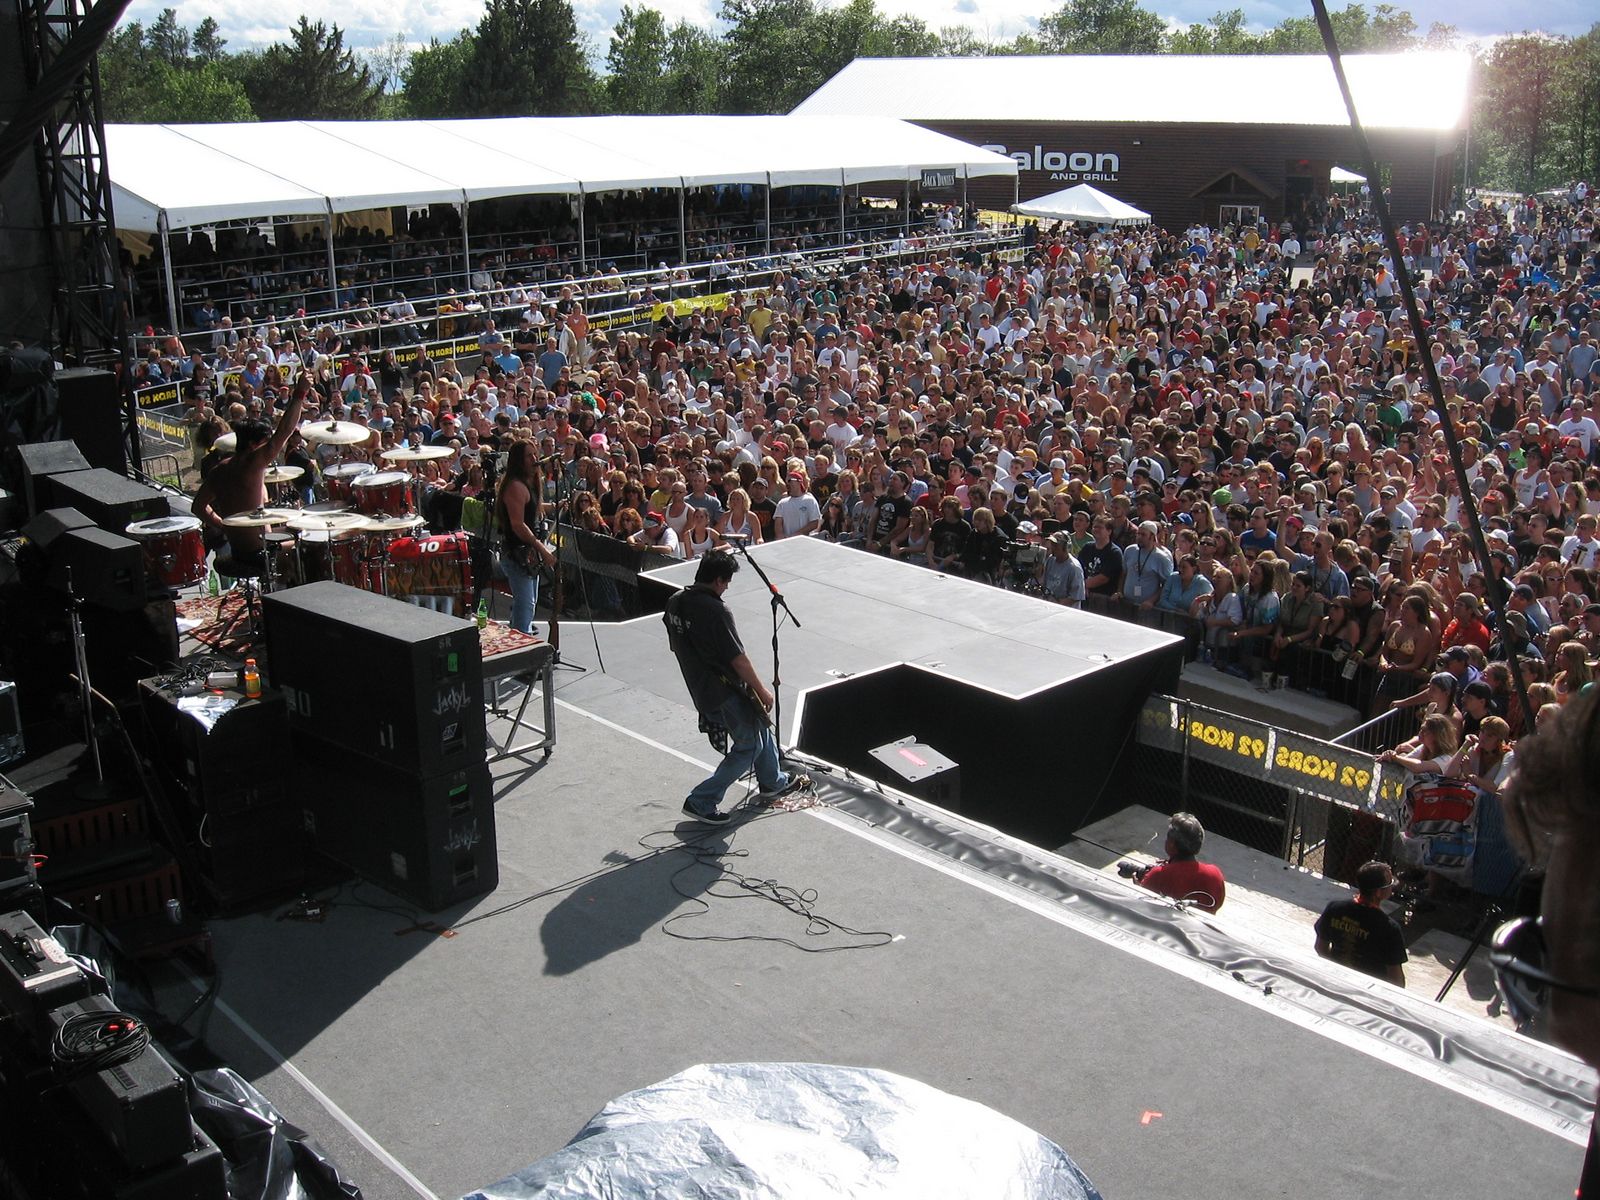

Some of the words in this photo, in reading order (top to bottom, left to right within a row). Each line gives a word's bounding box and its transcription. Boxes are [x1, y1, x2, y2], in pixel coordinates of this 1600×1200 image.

[1050, 172, 1078, 180] AND
[1082, 173, 1118, 181] GRILL
[419, 541, 440, 553] 10
[1330, 917, 1370, 940] SECURITY
